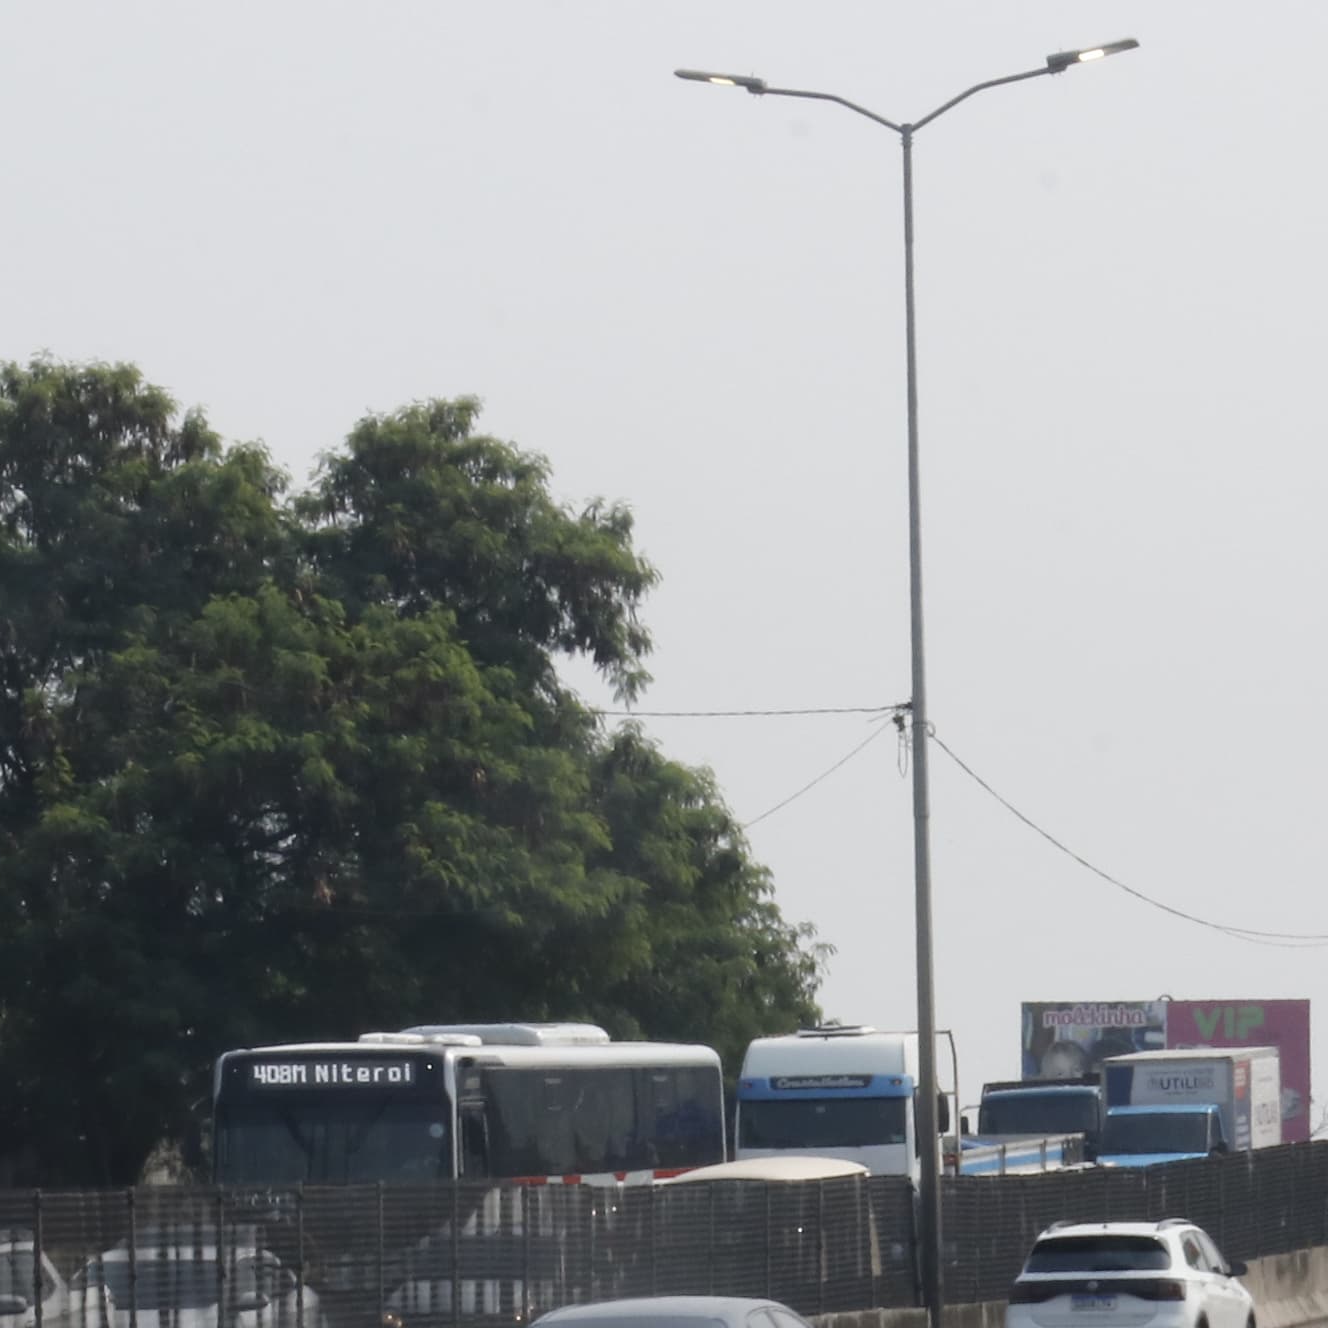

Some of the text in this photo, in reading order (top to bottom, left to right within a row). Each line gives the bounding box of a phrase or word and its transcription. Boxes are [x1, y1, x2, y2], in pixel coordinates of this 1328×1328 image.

[1193, 1006, 1265, 1040] VIP
[253, 1063, 410, 1083] 408M Niteroi
